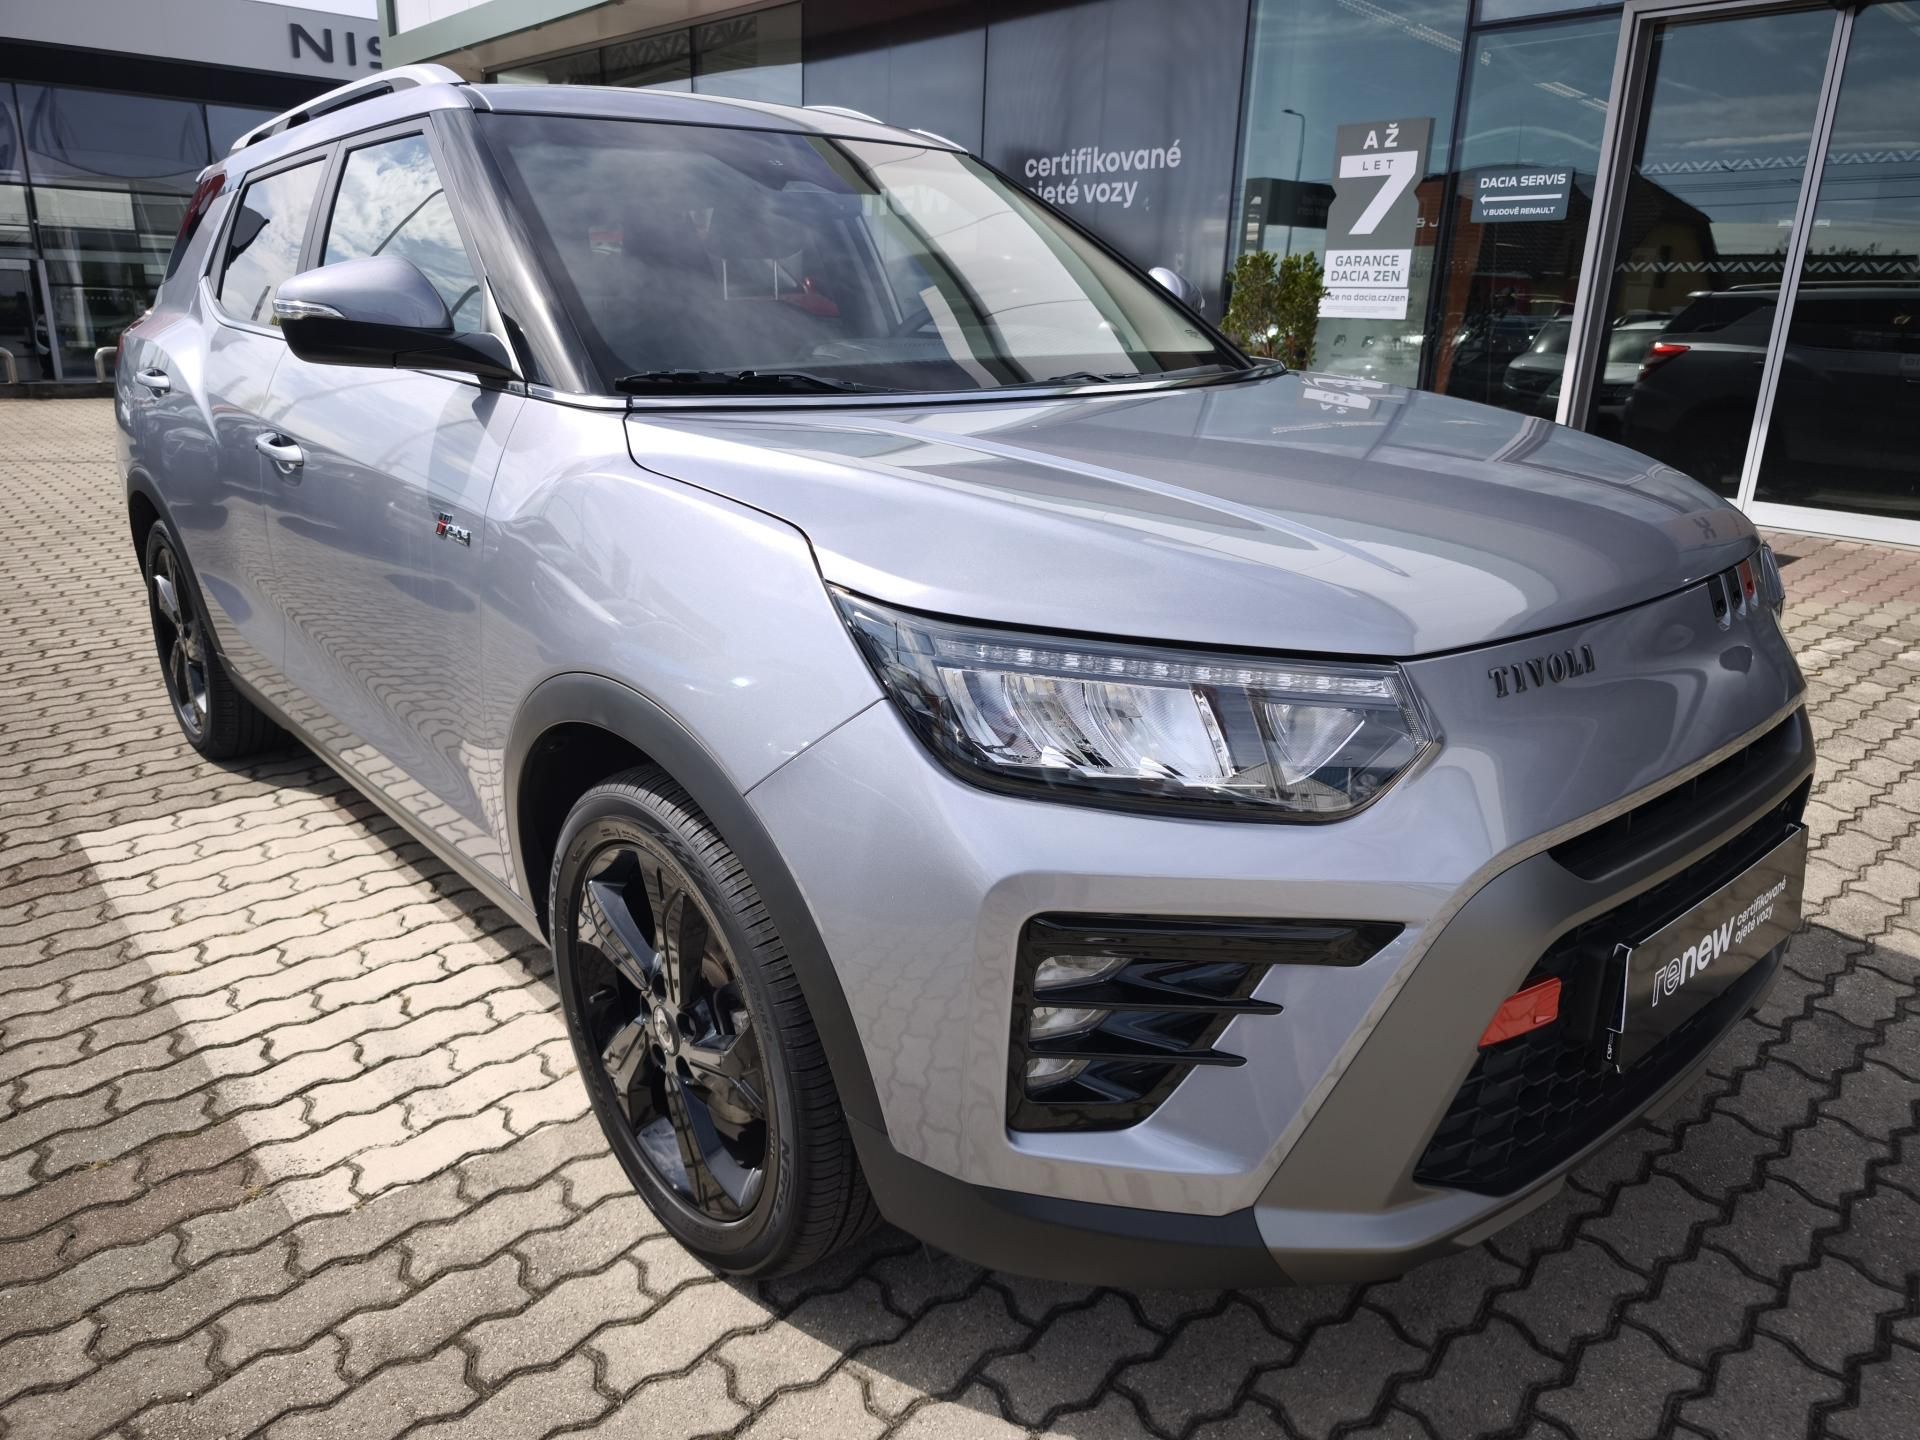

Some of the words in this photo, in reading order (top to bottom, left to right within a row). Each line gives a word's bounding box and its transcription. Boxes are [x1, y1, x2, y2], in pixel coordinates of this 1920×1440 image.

[1363, 123, 1399, 149] AŽ
[1025, 139, 1182, 178] certifikované
[1362, 160, 1394, 171] LET
[1027, 178, 1079, 205] jeté
[1083, 181, 1139, 208] vozy
[1339, 150, 1419, 235] 7
[1480, 177, 1517, 188] DACIA
[1520, 174, 1566, 187] SERVIS
[1489, 206, 1519, 216] BUDOVĚ
[1521, 206, 1555, 215] RENAULT
[1335, 255, 1399, 267] GARANCE
[1331, 270, 1370, 282] DACIA
[1341, 294, 1352, 302] na
[1354, 293, 1406, 303] dacia.cz/zen
[1488, 644, 1595, 698] TIVOLI
[1737, 875, 1786, 926] certifikované
[1735, 915, 1756, 944] ojeté
[1756, 903, 1774, 927] vozy
[1652, 916, 1735, 1007] renew
